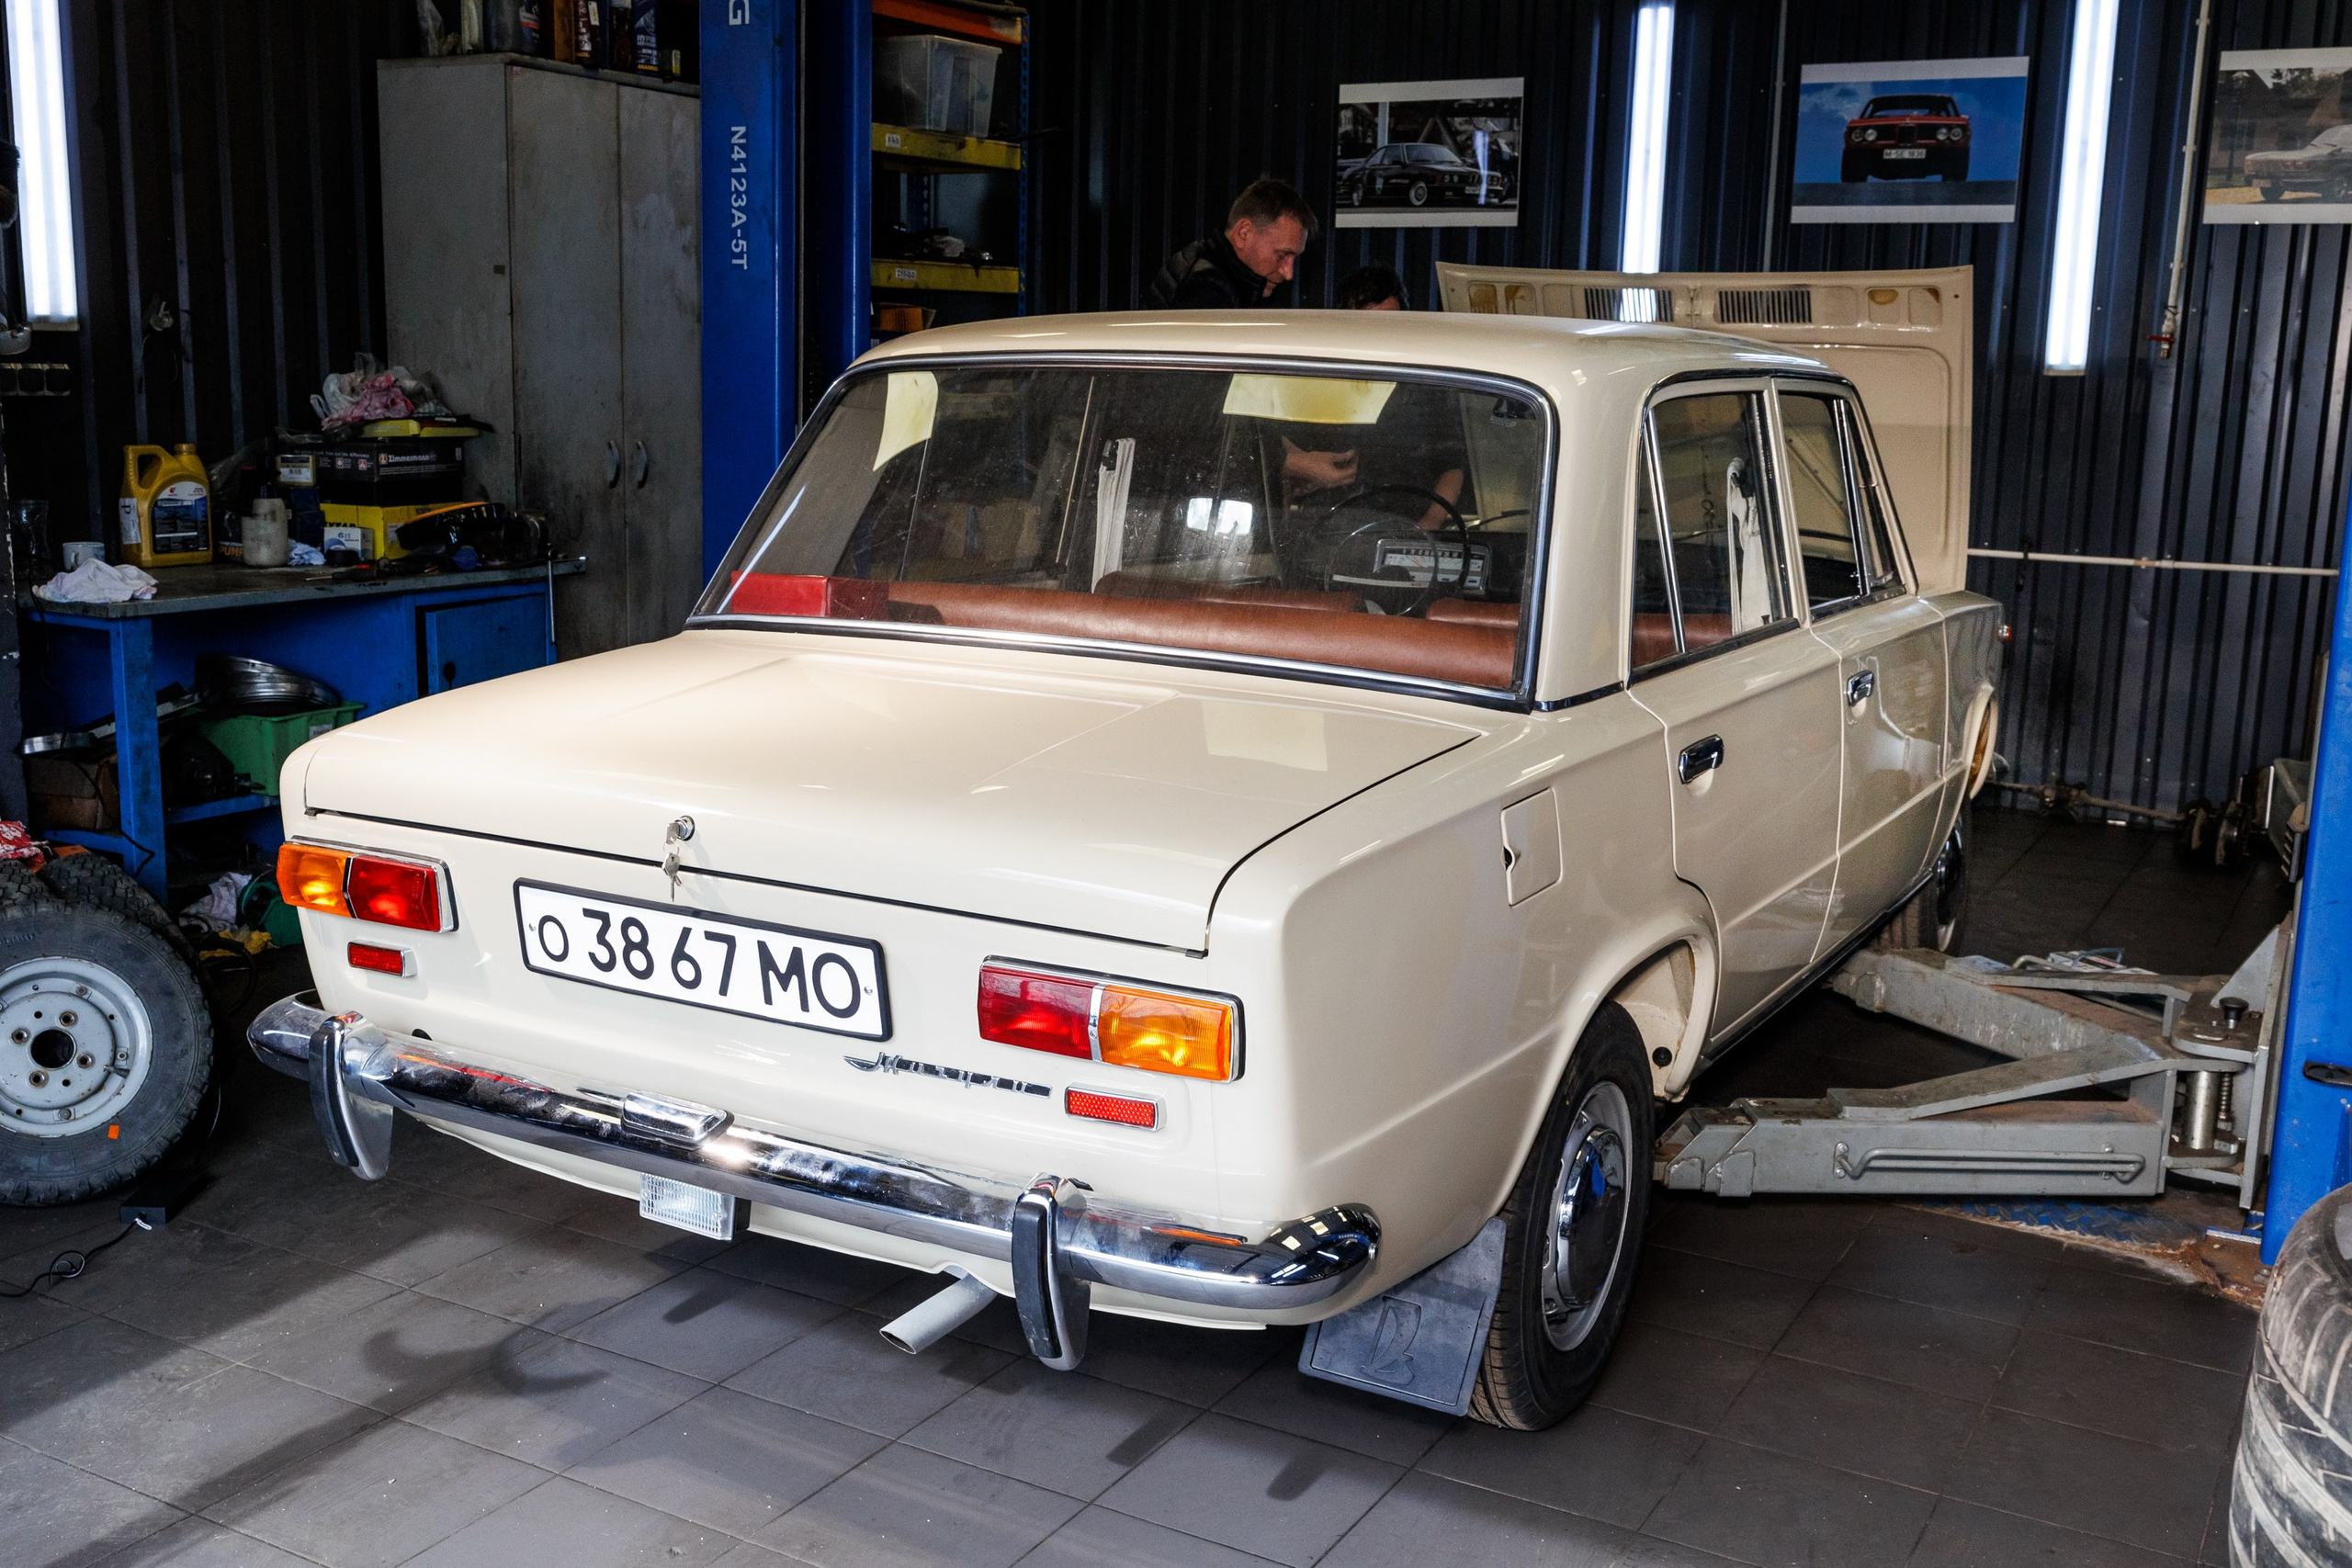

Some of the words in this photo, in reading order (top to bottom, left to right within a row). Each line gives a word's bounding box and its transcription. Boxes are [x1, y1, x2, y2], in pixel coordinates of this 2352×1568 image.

[730, 126, 748, 270] N4123A-5T
[388, 454, 430, 463] Zimmermann
[757, 940, 862, 1019] МО
